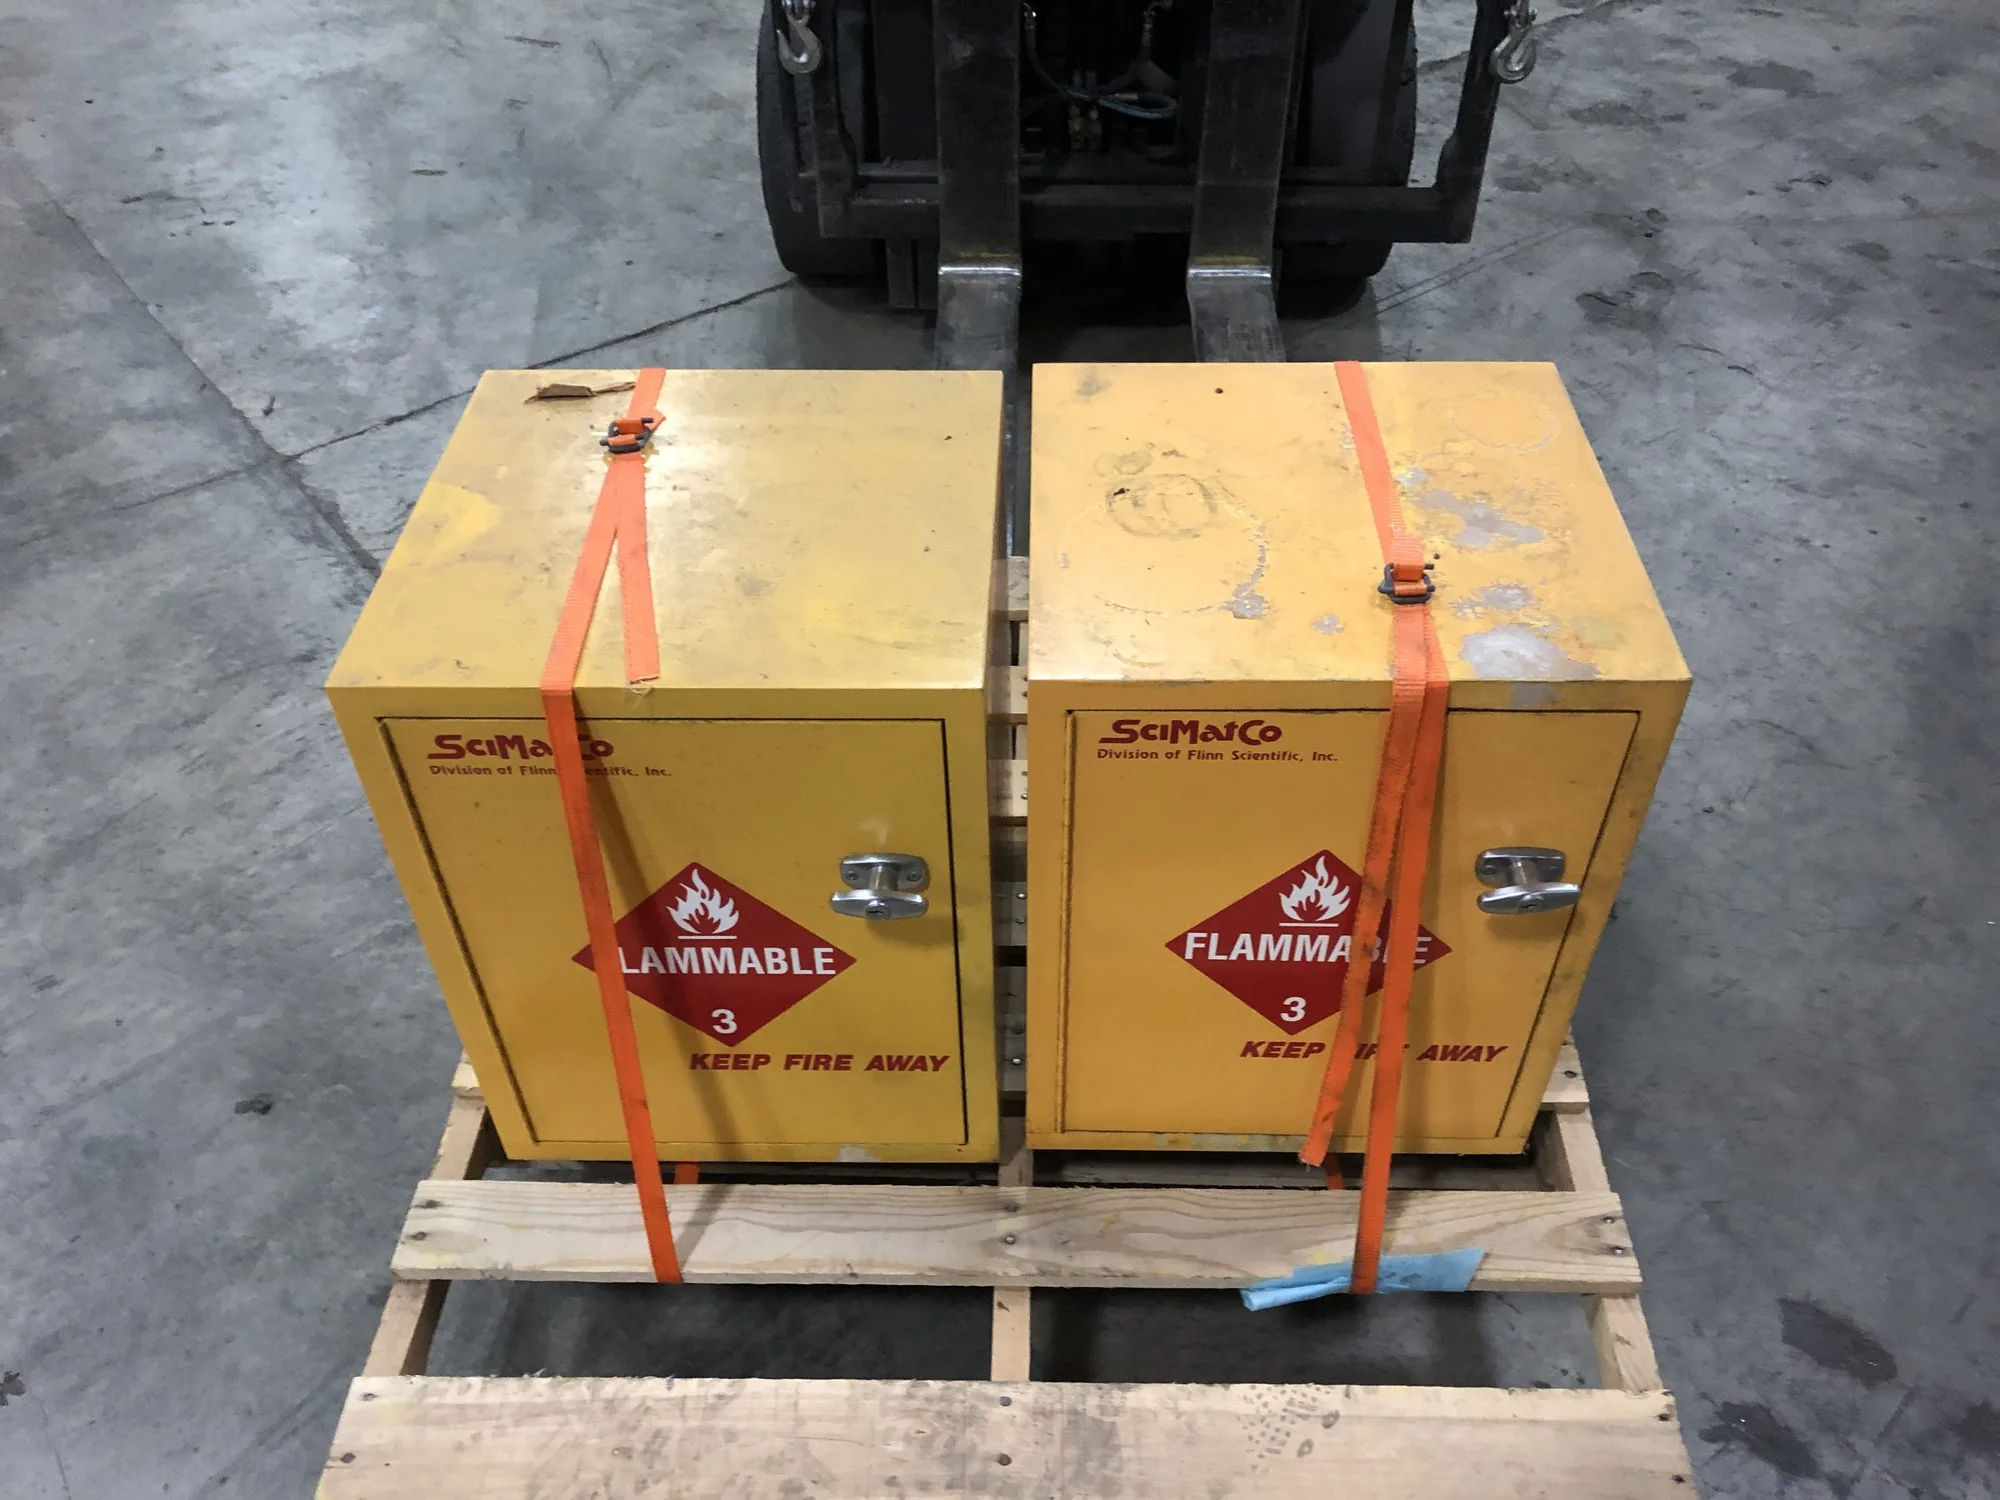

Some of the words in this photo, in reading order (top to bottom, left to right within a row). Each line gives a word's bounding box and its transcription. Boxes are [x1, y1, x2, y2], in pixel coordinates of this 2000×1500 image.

[1098, 718, 1283, 746] SciMatCo
[1097, 749, 1159, 760] Division
[1164, 749, 1181, 760] of
[1187, 750, 1224, 761] Flinn
[1231, 750, 1304, 763] Scientific,
[1311, 751, 1339, 762] Inc.
[428, 765, 493, 776] Division
[497, 765, 513, 776] of
[520, 765, 557, 776] Flinn
[644, 767, 673, 777] Inc.
[617, 945, 837, 976] LAMMABLE
[711, 1008, 738, 1035] 3
[1280, 996, 1307, 1023] 3
[688, 1053, 771, 1071] KEEP
[783, 1054, 854, 1071] FIRE
[864, 1055, 951, 1072] AWAY
[1239, 1041, 1326, 1059] KEEP
[1416, 1045, 1508, 1063] AWAY
